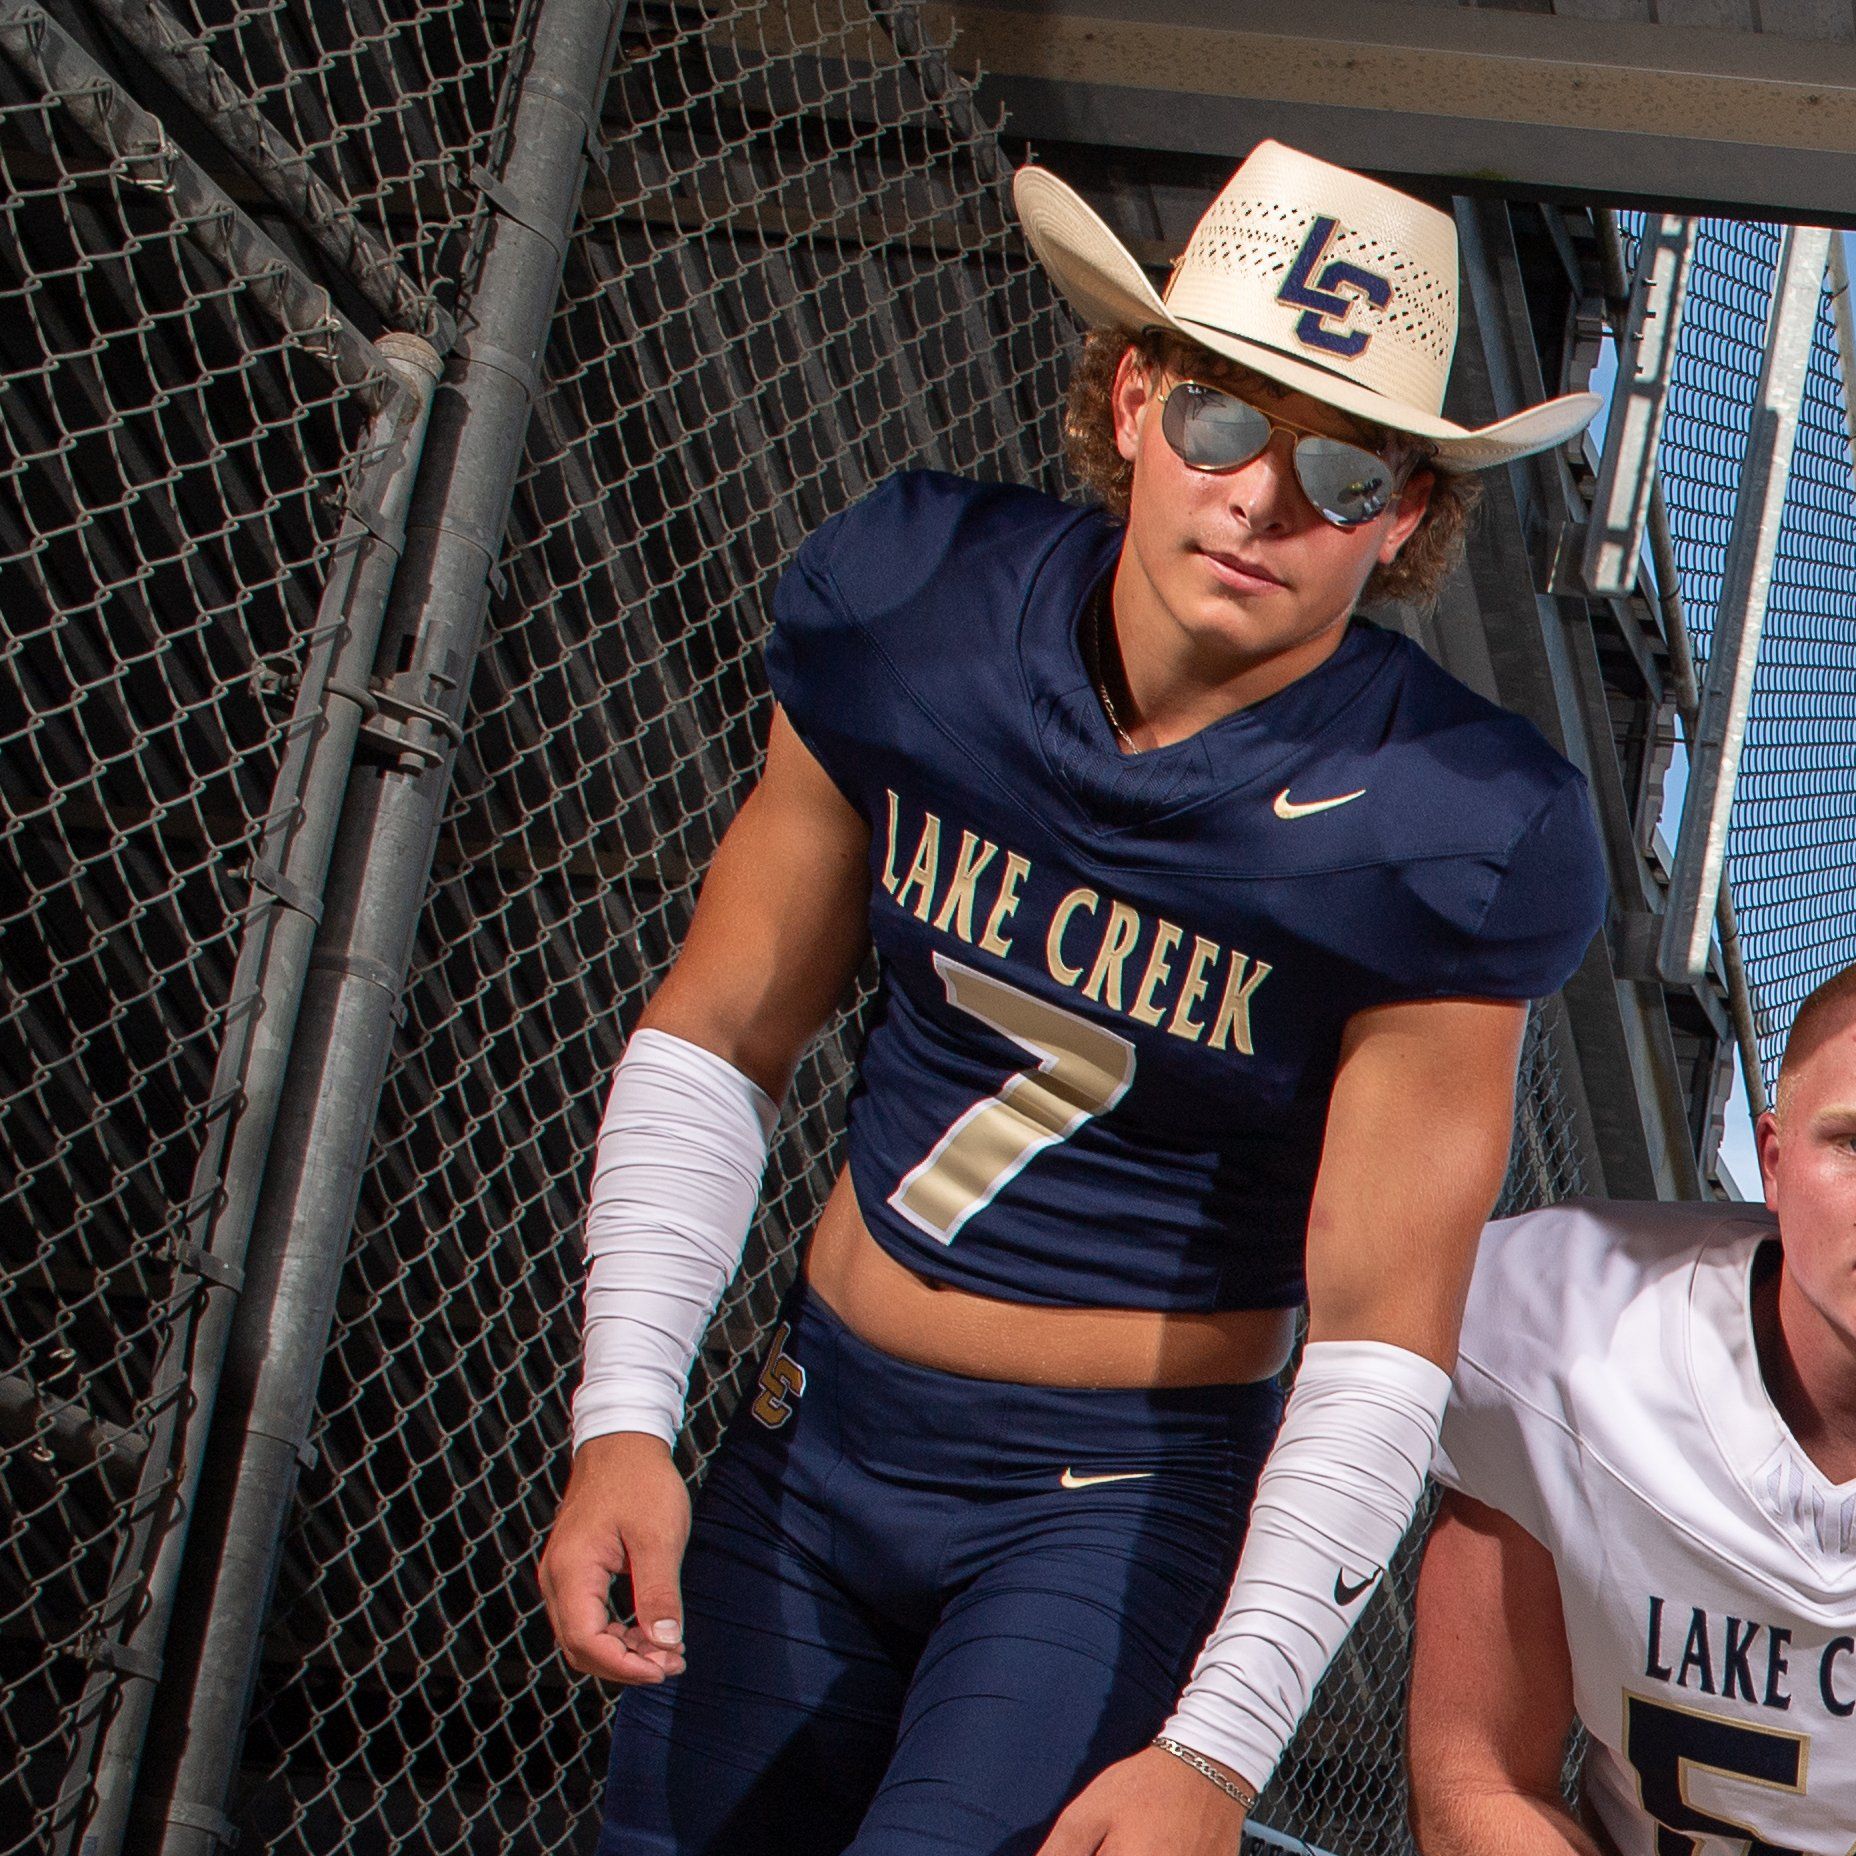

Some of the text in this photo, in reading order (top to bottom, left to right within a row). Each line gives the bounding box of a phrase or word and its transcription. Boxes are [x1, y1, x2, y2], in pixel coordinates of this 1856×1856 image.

[1275, 213, 1395, 362] LC
[882, 788, 1273, 1056] LAKE CREEK
[887, 951, 1137, 1246] 7
[1645, 1596, 1792, 1711] LAKE
